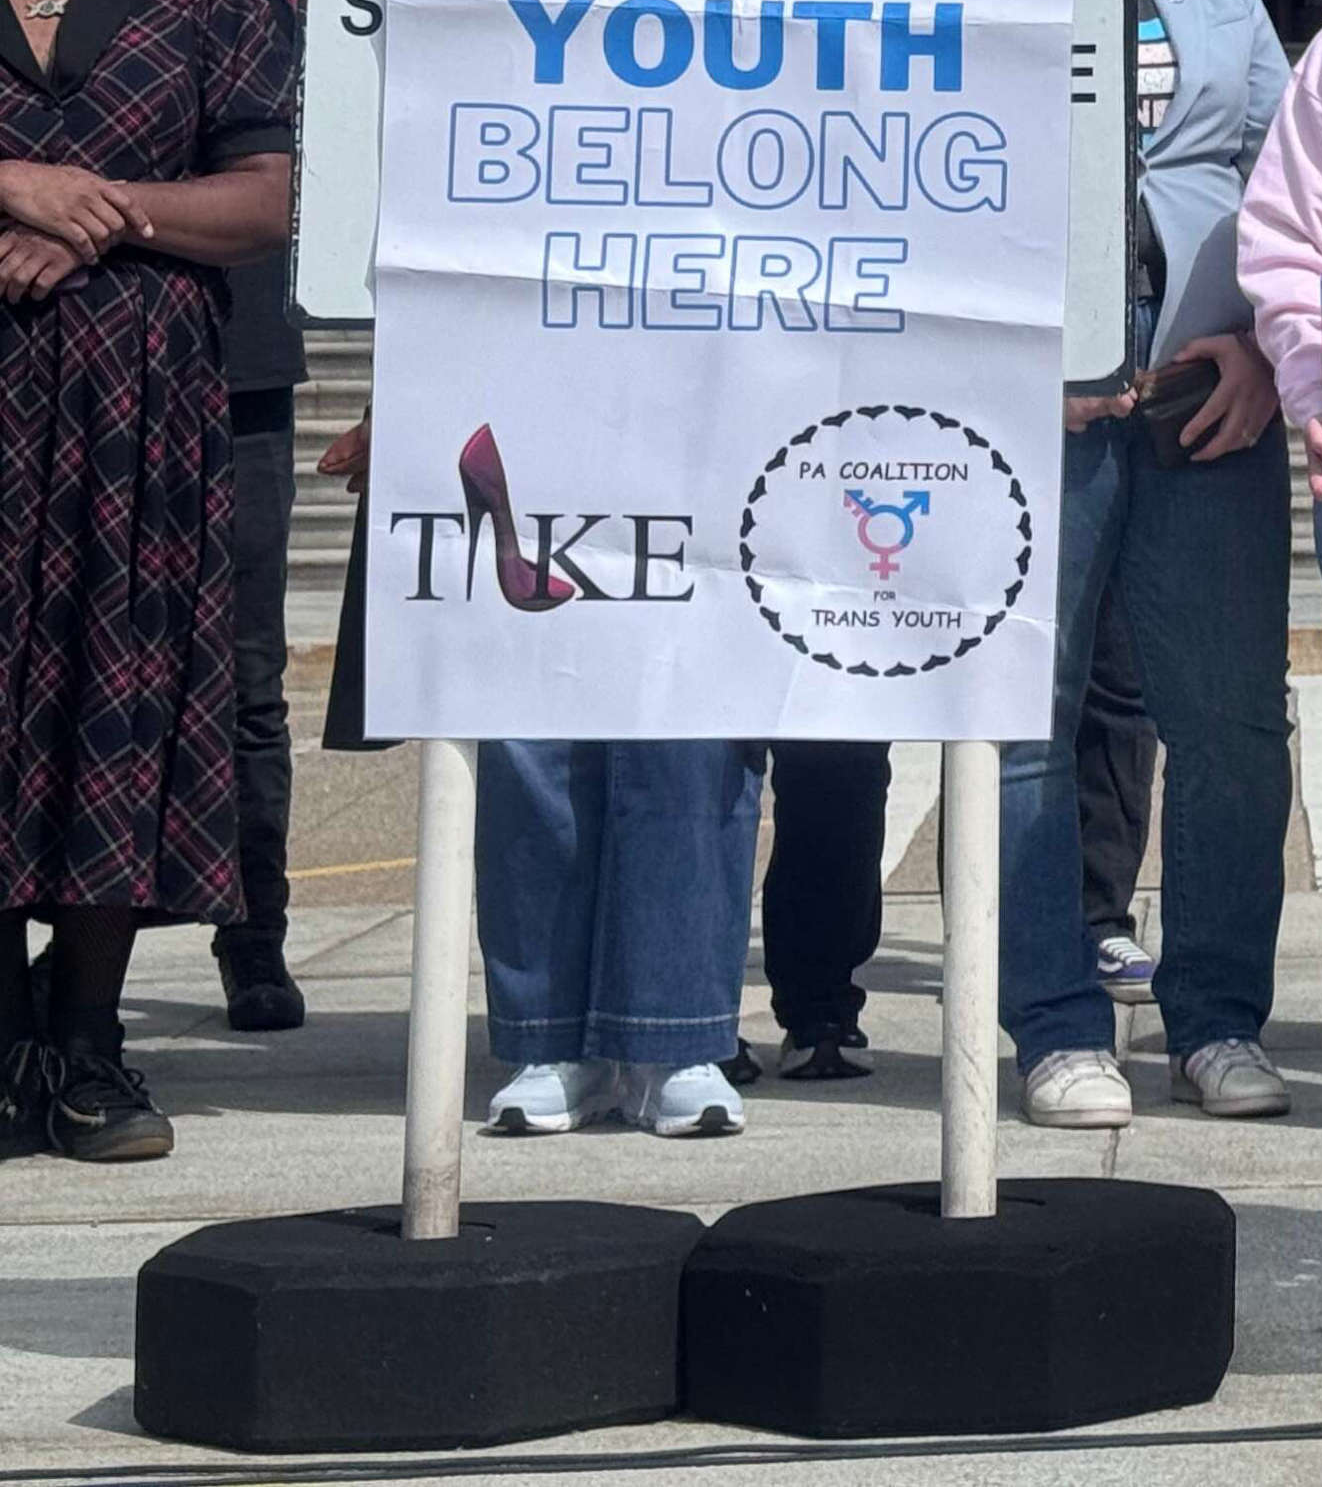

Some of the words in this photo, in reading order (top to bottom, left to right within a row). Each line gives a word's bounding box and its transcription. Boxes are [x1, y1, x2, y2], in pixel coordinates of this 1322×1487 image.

[447, 102, 1008, 213] BELONG
[541, 231, 909, 334] HERE
[799, 462, 826, 480] PA
[839, 461, 969, 482] COALITION
[873, 590, 897, 602] FOR
[811, 609, 881, 629] TRANS
[892, 610, 962, 629] YOUTH
